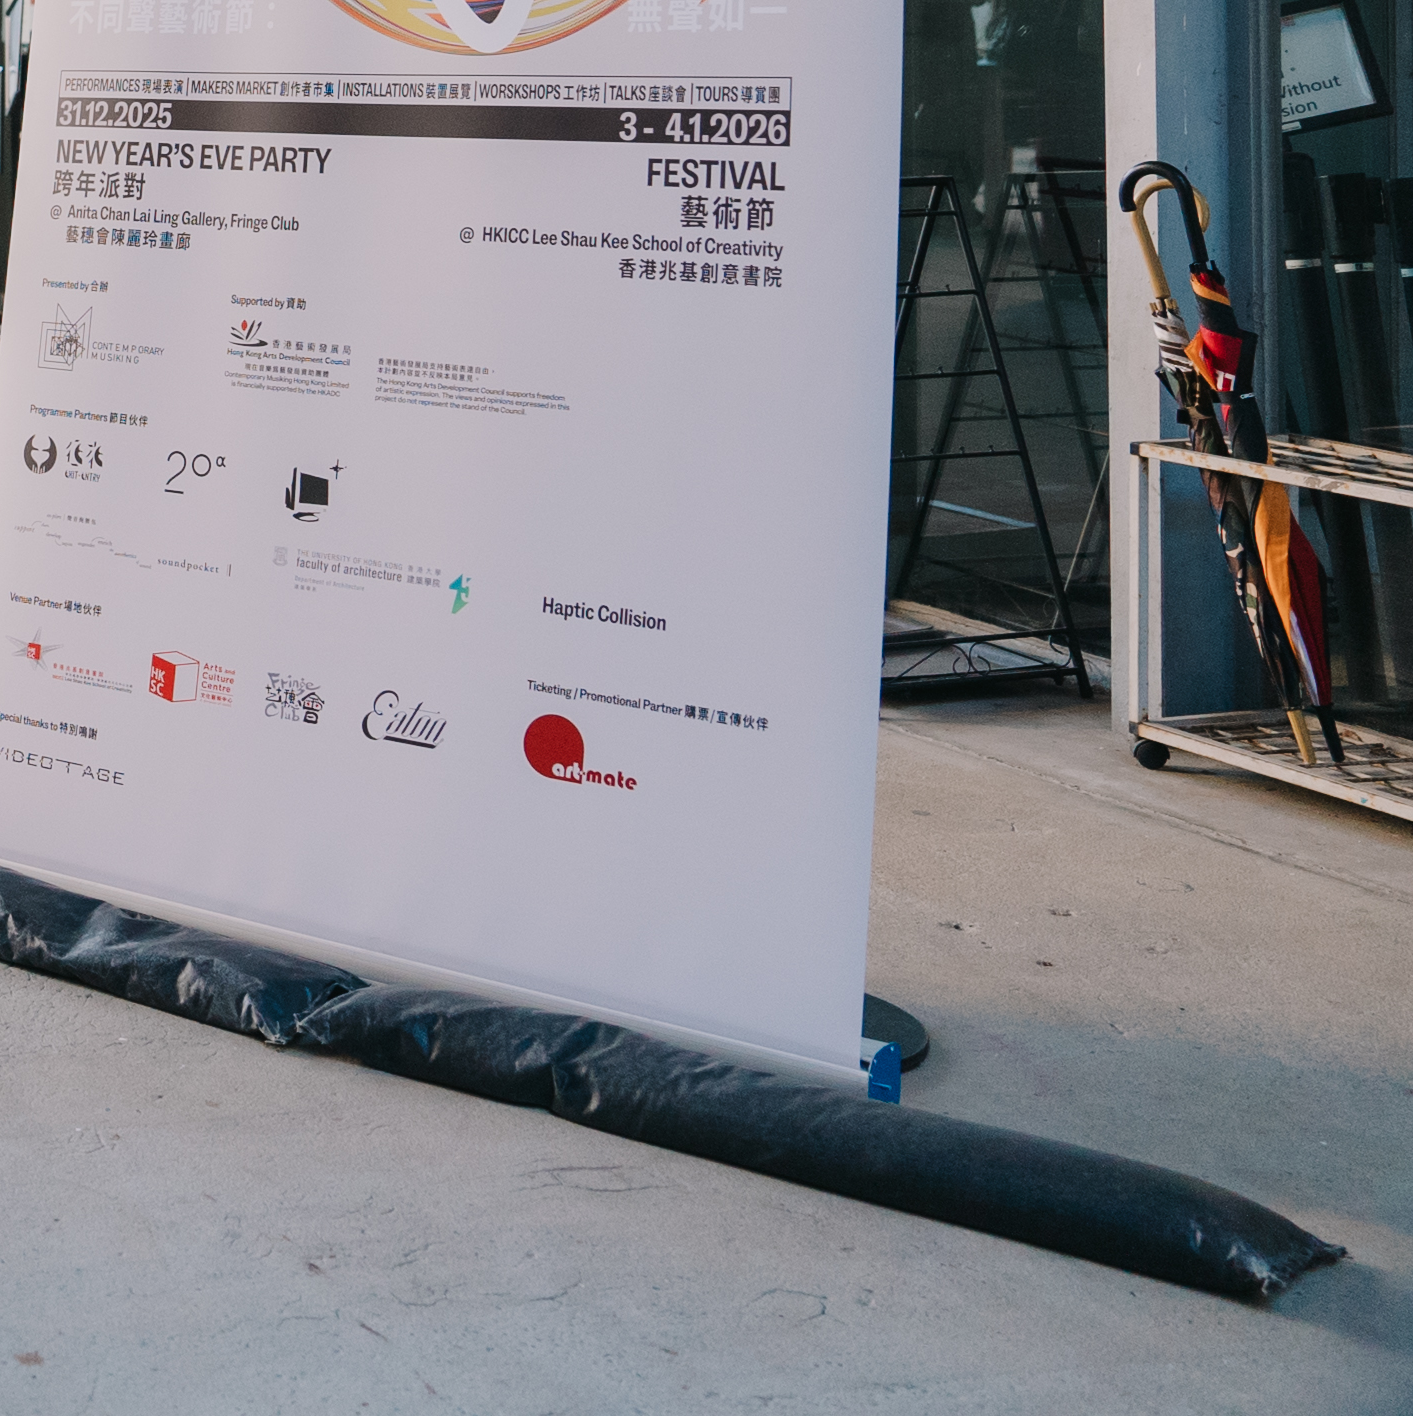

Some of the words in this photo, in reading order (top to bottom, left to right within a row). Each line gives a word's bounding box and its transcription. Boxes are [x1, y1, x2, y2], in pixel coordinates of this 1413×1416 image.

[65, 78, 140, 93] PERFORMANCES
[142, 79, 183, 95] 現場表演
[191, 81, 234, 95] MAKERS
[235, 81, 278, 96] MARKET
[342, 83, 423, 98] INSTALLATIONS
[479, 84, 561, 100] WORSKSHOPS
[563, 85, 600, 102] 工作坊
[609, 85, 646, 101] TALKS
[648, 86, 686, 103] 座談會
[696, 86, 739, 102] TOURS
[740, 86, 780, 104] 導賞團
[59, 101, 172, 128] 31.12.2025
[665, 113, 787, 144] 4.1.2026
[56, 140, 108, 164] NEW
[110, 141, 194, 169] YEAR'S
[200, 145, 243, 171] EVE
[250, 146, 332, 174] PARTY
[647, 158, 785, 191] FESTIVAL
[53, 170, 146, 200] 跨年派對
[67, 205, 98, 220] Anita
[100, 207, 131, 221] Chan
[133, 208, 151, 223] Lai
[154, 209, 179, 227] Ling
[182, 211, 228, 230] Gallery,
[231, 213, 268, 232] Fringe
[271, 215, 299, 231] Club
[680, 196, 775, 230] 藝術節
[482, 227, 529, 245] HKICC
[532, 229, 557, 245] Lee
[561, 230, 597, 247] Shau
[601, 232, 629, 249] Kee
[632, 235, 682, 252] School
[686, 238, 702, 253] of
[704, 239, 783, 261] Creativity
[618, 258, 783, 287] 香港兆基創意書院
[42, 278, 78, 289] Presented
[80, 280, 89, 292] by
[231, 295, 272, 308] Supported
[274, 297, 285, 310] by
[286, 297, 306, 311] 資助
[91, 352, 139, 364] MUSIKING
[92, 341, 165, 356] CONTEMPORARY
[227, 348, 244, 358] Hong
[246, 350, 262, 359] Kong
[263, 351, 276, 360] Arts
[279, 353, 323, 364] Development
[325, 357, 350, 366] Council
[30, 404, 72, 419] Programme
[74, 408, 108, 423] Partners
[157, 558, 219, 574] soundpocket
[296, 558, 328, 574] faculty
[332, 562, 341, 573] of
[343, 565, 402, 582] architecture
[10, 593, 32, 604] Venue
[34, 596, 62, 609] Partner
[543, 596, 594, 620] Haptic
[597, 605, 667, 631] Collision
[151, 666, 165, 682] HK
[204, 663, 223, 673] Arts
[201, 681, 231, 693] Centre
[202, 672, 235, 684] Culture
[267, 672, 321, 695] Fringe
[150, 681, 164, 696] SC
[527, 679, 572, 700] Ticketing
[579, 688, 641, 709] Promotional
[643, 698, 683, 717] Partner
[265, 703, 299, 722] Club
[24, 716, 48, 731] thanks
[50, 722, 58, 732] to
